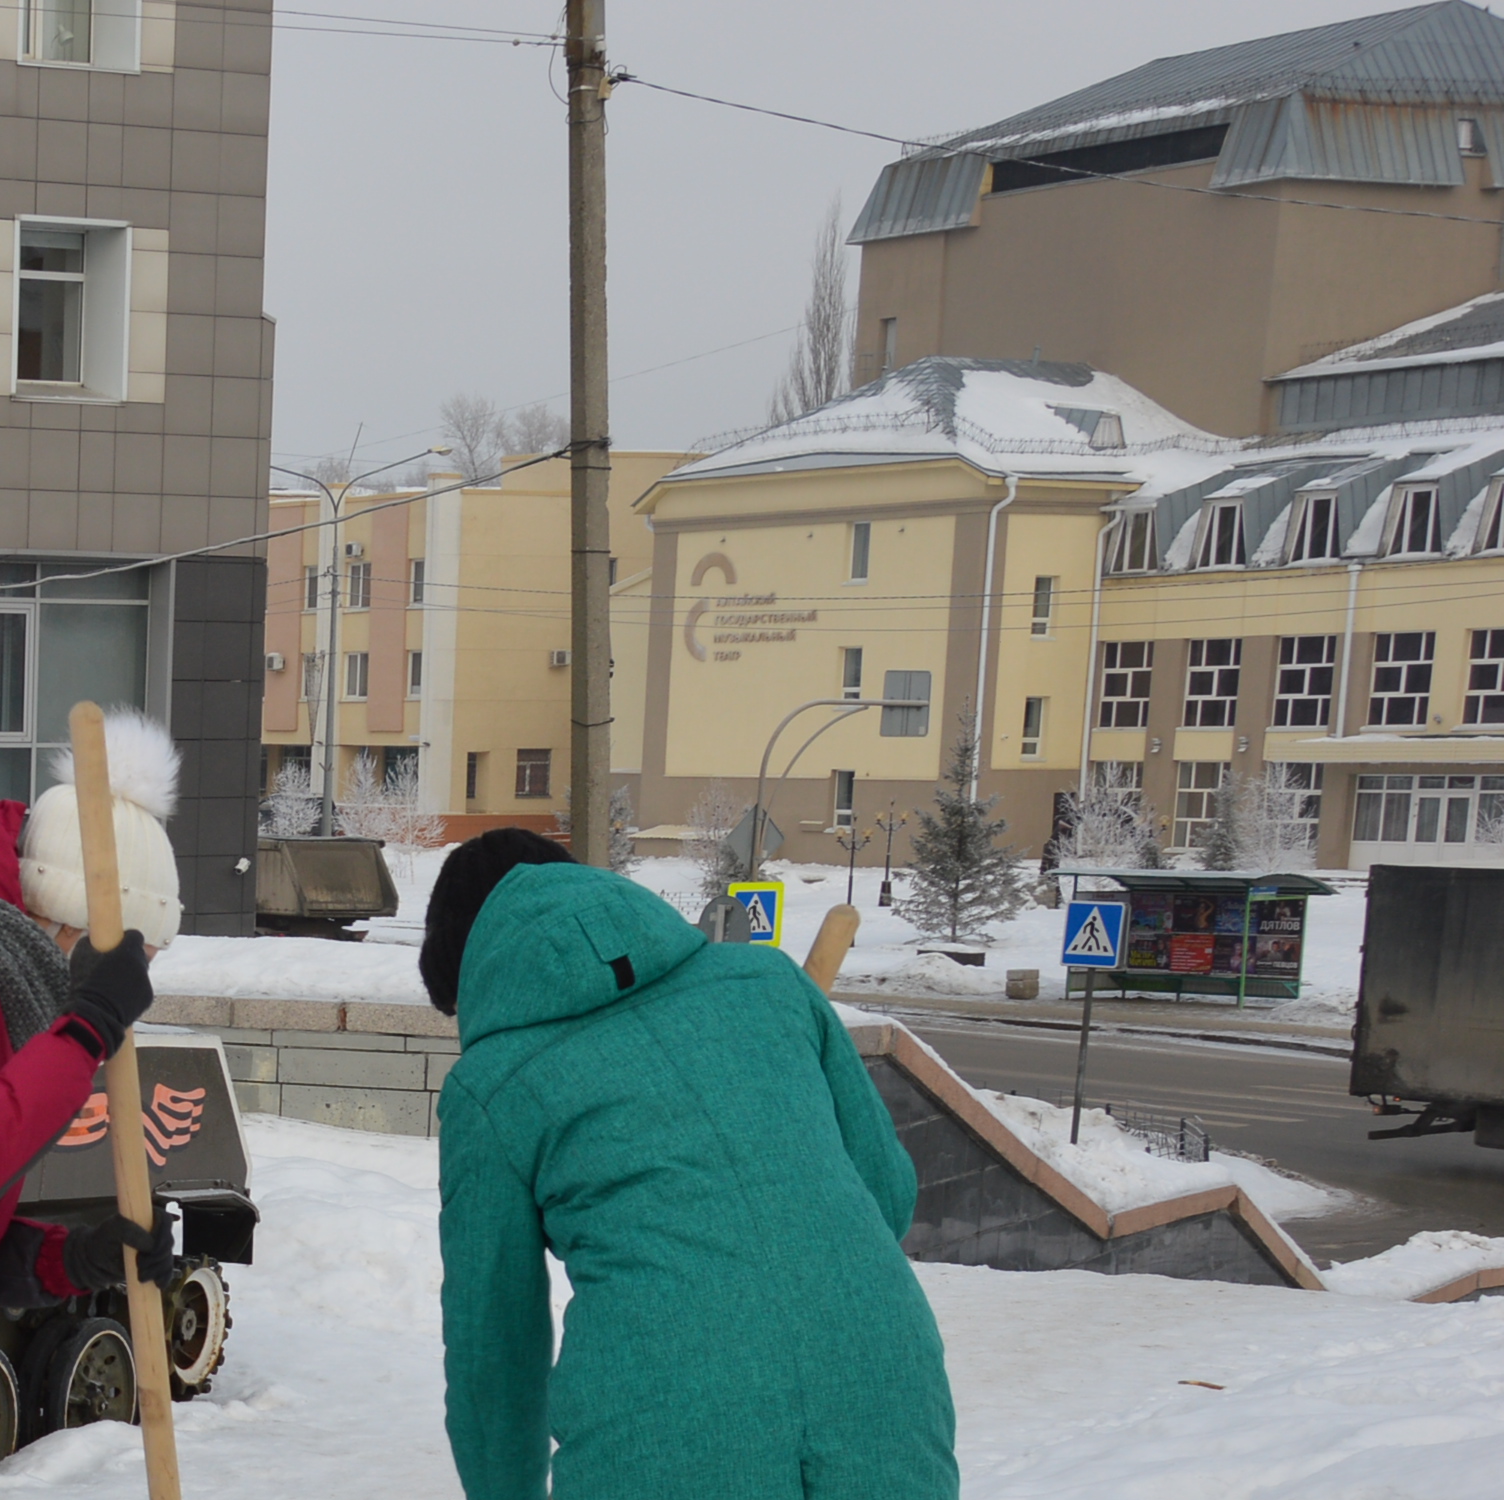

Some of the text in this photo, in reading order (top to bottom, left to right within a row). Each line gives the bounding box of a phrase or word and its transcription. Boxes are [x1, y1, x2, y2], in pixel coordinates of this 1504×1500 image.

[714, 610, 818, 626] ГОСУДАРСТВЕННЫЙ
[713, 629, 797, 643] МУЗЫКАЛЬНЫЙ
[713, 651, 741, 661] ТЕАТР
[1259, 920, 1301, 931] ДЯТЛОВ
